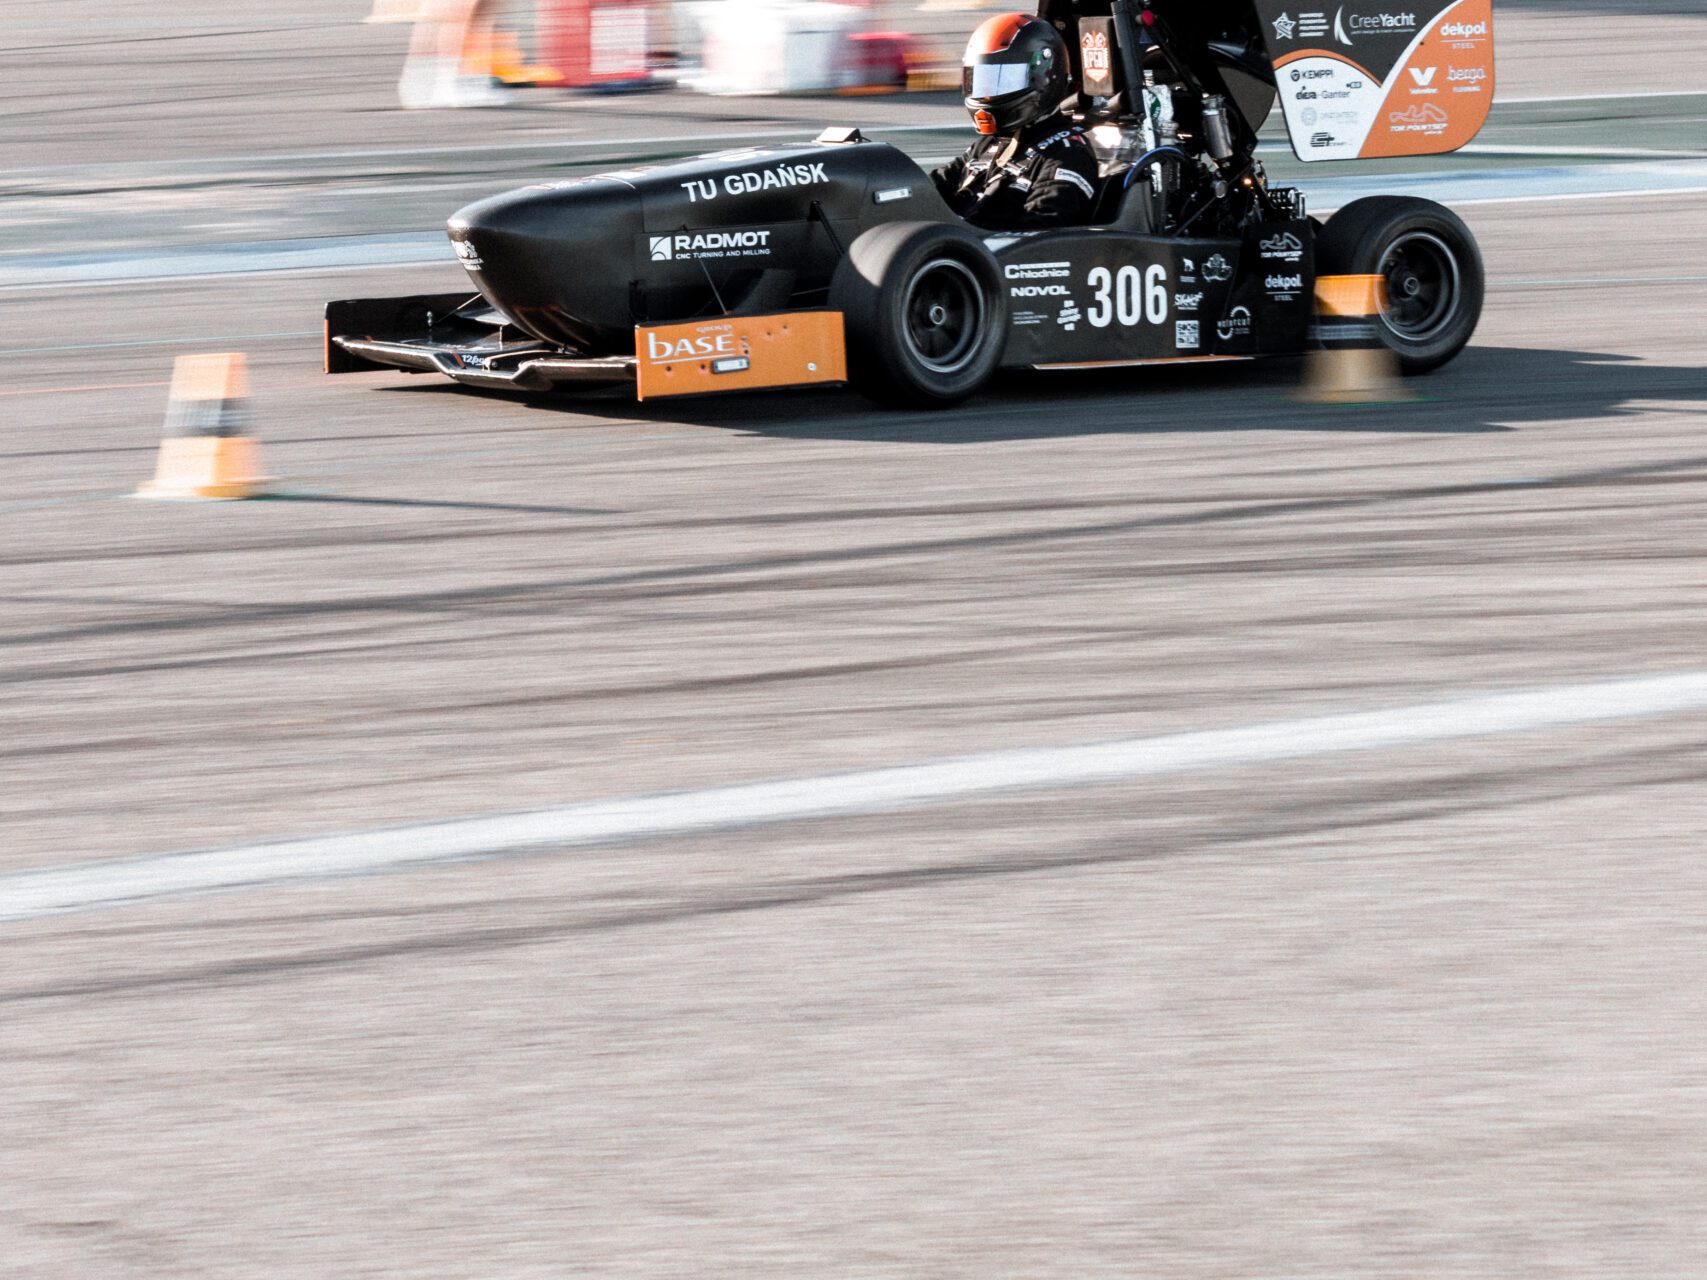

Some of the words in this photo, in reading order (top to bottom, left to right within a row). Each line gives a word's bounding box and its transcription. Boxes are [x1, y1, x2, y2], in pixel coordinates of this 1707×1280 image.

[1349, 11, 1416, 28] CreeYacht
[1440, 20, 1488, 38] dekpol
[1302, 69, 1333, 79] KEMPPI
[681, 180, 718, 203] TU
[723, 162, 830, 195] GDAŃSK
[674, 231, 770, 250] RADMOT
[693, 251, 724, 259] TURNING
[742, 248, 771, 256] MILLING
[1264, 273, 1303, 290] dekpol
[1010, 285, 1071, 297] NOVOL
[1087, 264, 1168, 328] 306
